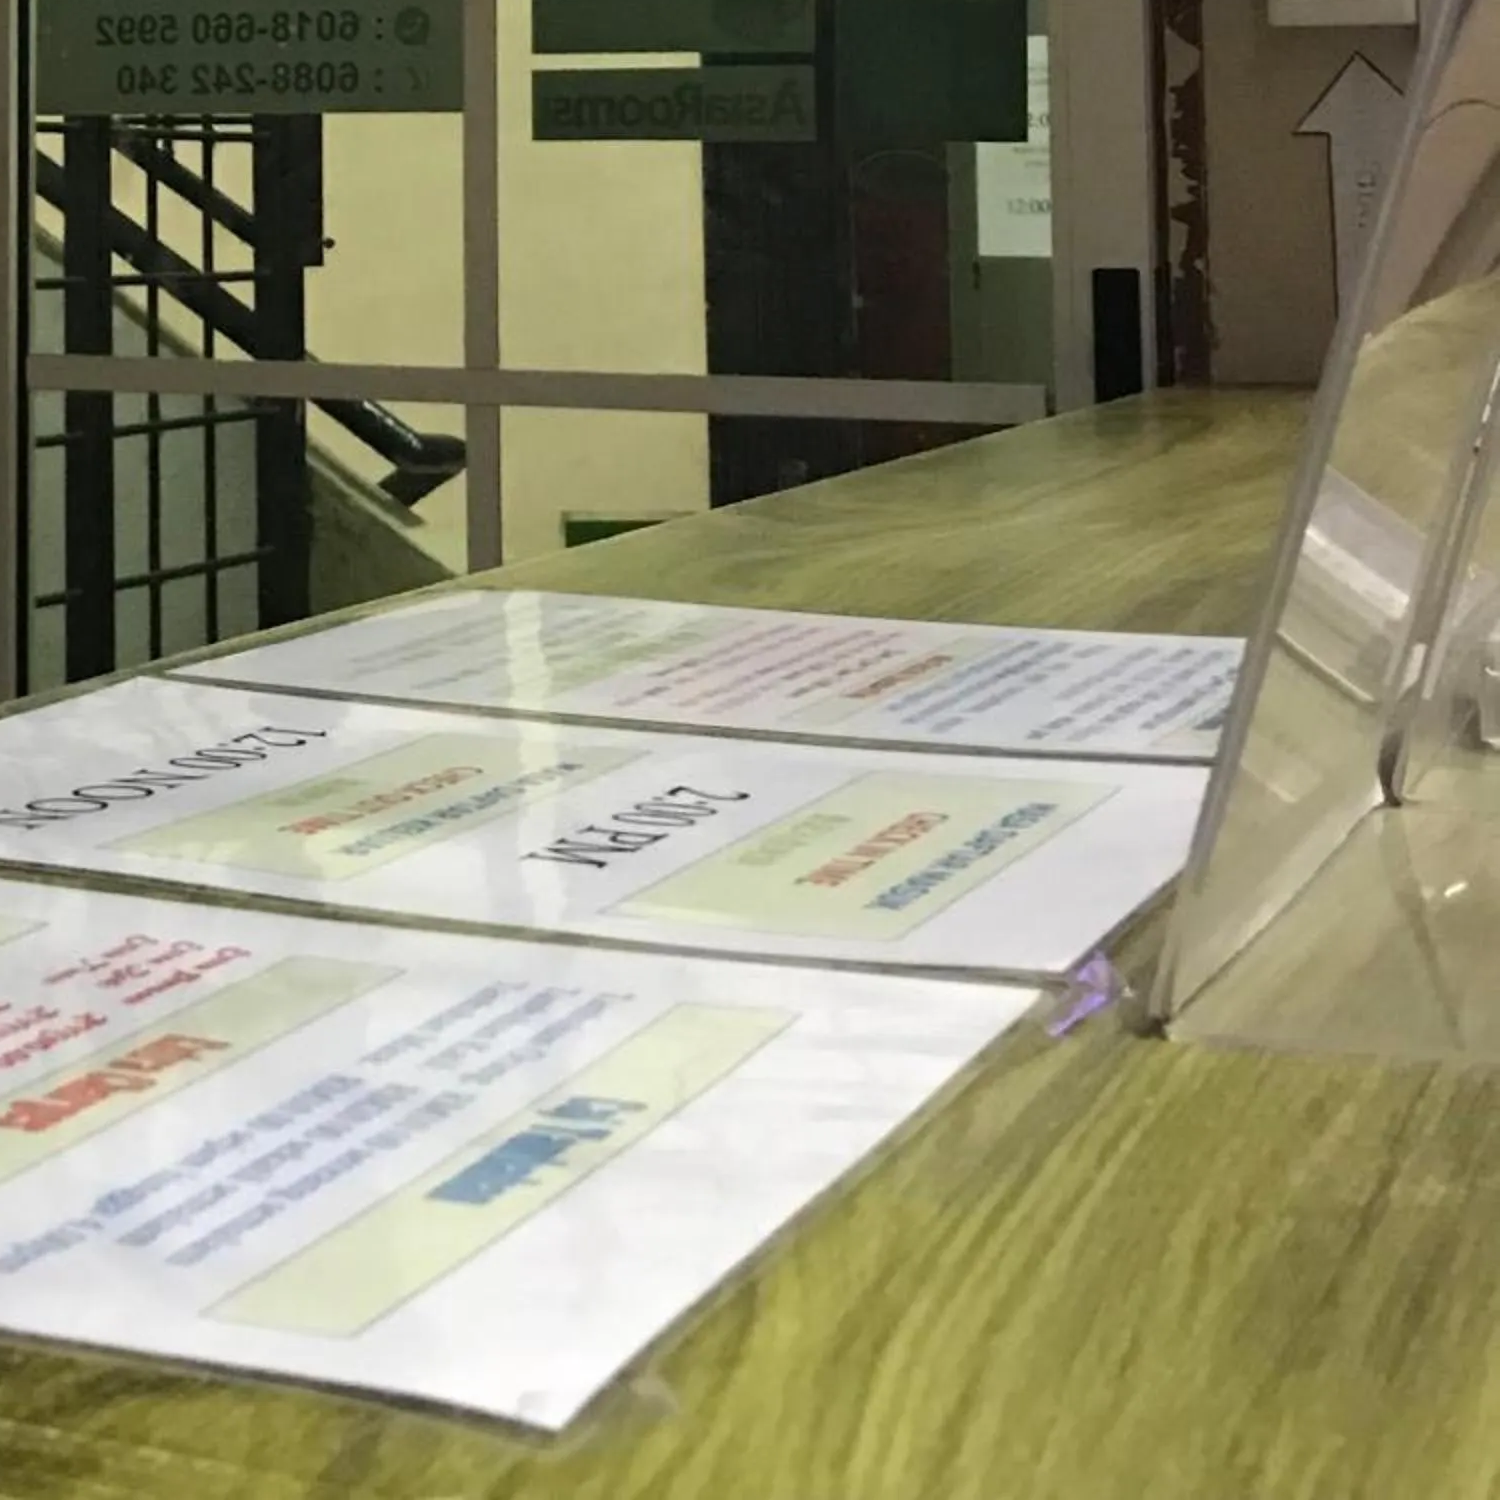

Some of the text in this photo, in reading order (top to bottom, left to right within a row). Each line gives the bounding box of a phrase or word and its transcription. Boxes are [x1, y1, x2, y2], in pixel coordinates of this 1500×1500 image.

[169, 727, 327, 772] 12:00
[611, 785, 750, 827] 2:00
[519, 823, 670, 869] PM
